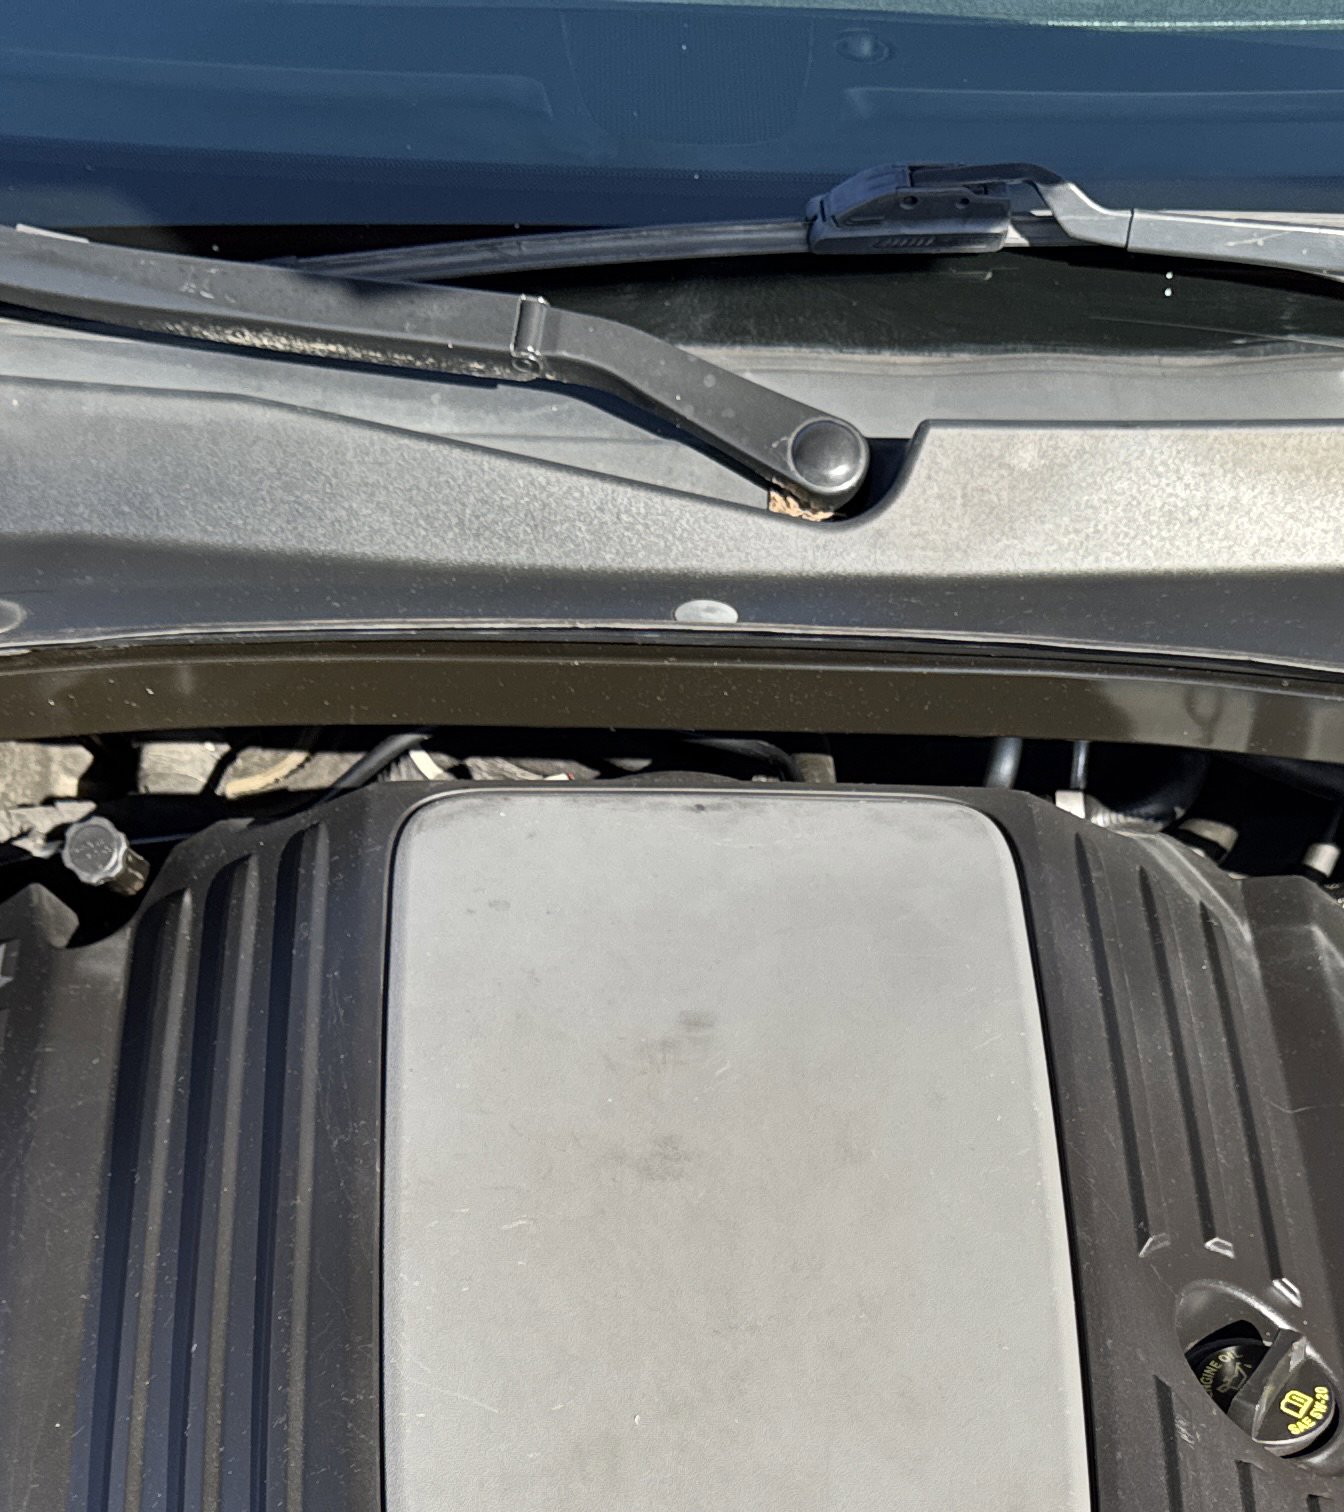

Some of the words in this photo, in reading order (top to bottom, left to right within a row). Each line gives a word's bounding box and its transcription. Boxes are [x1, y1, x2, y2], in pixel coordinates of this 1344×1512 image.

[1199, 1359, 1223, 1398] NGINE
[1287, 1415, 1317, 1436] SAE
[1309, 1385, 1330, 1420] 5W-20
